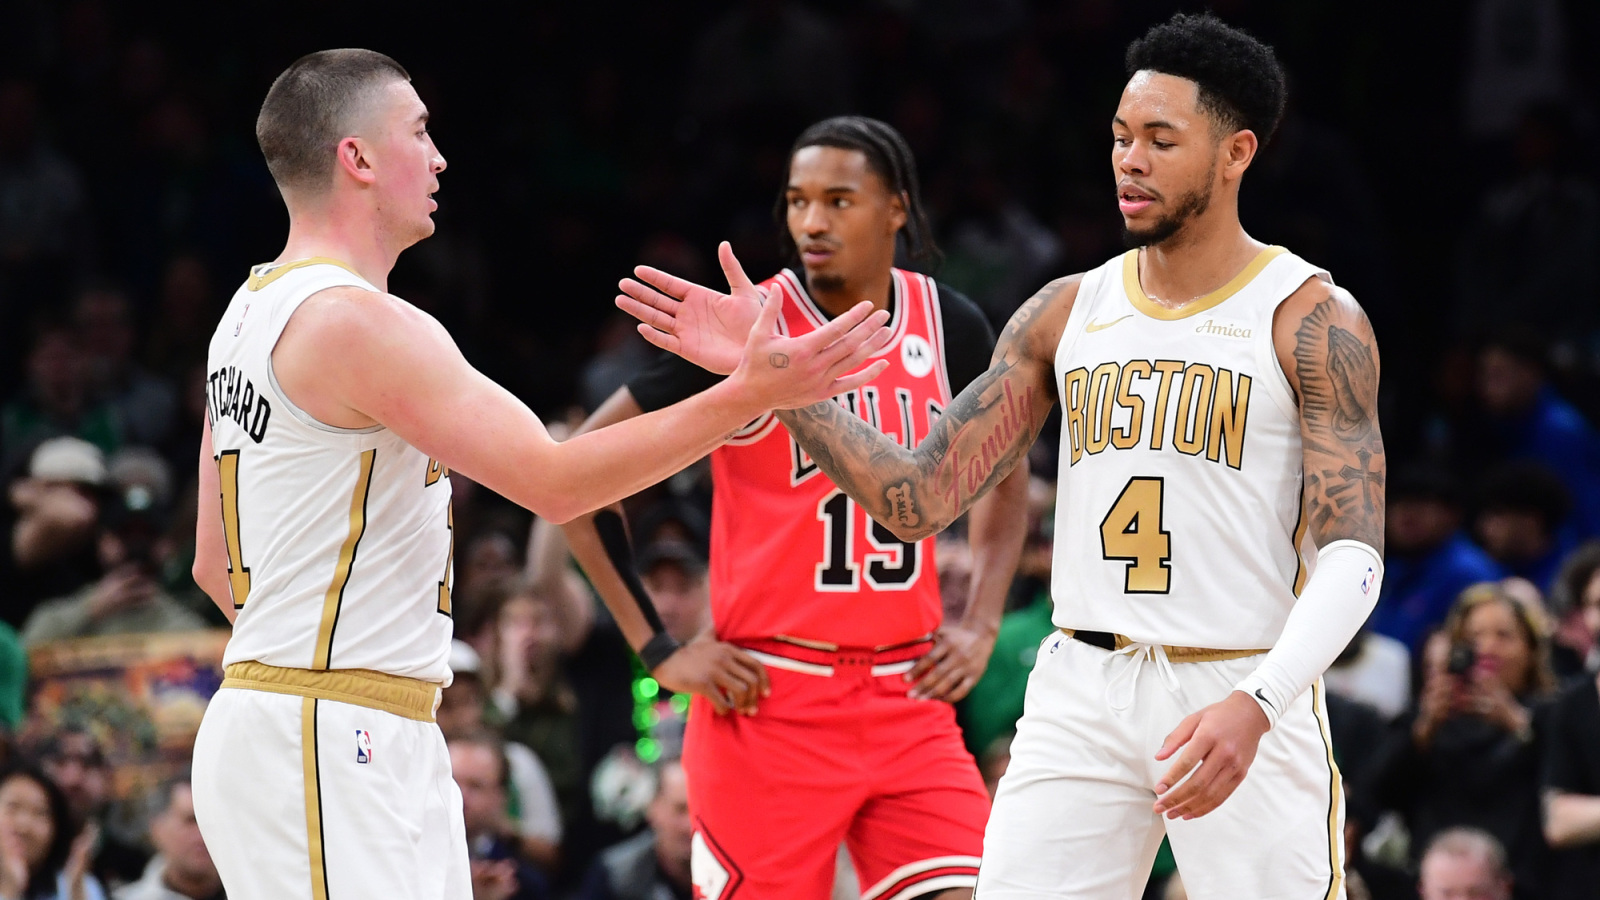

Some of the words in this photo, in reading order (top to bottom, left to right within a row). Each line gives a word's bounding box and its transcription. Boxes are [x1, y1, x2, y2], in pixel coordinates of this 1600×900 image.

[1195, 319, 1252, 338] Amica
[934, 378, 1036, 518] Family
[1065, 359, 1252, 471] BOSTON
[1099, 476, 1172, 594] 4
